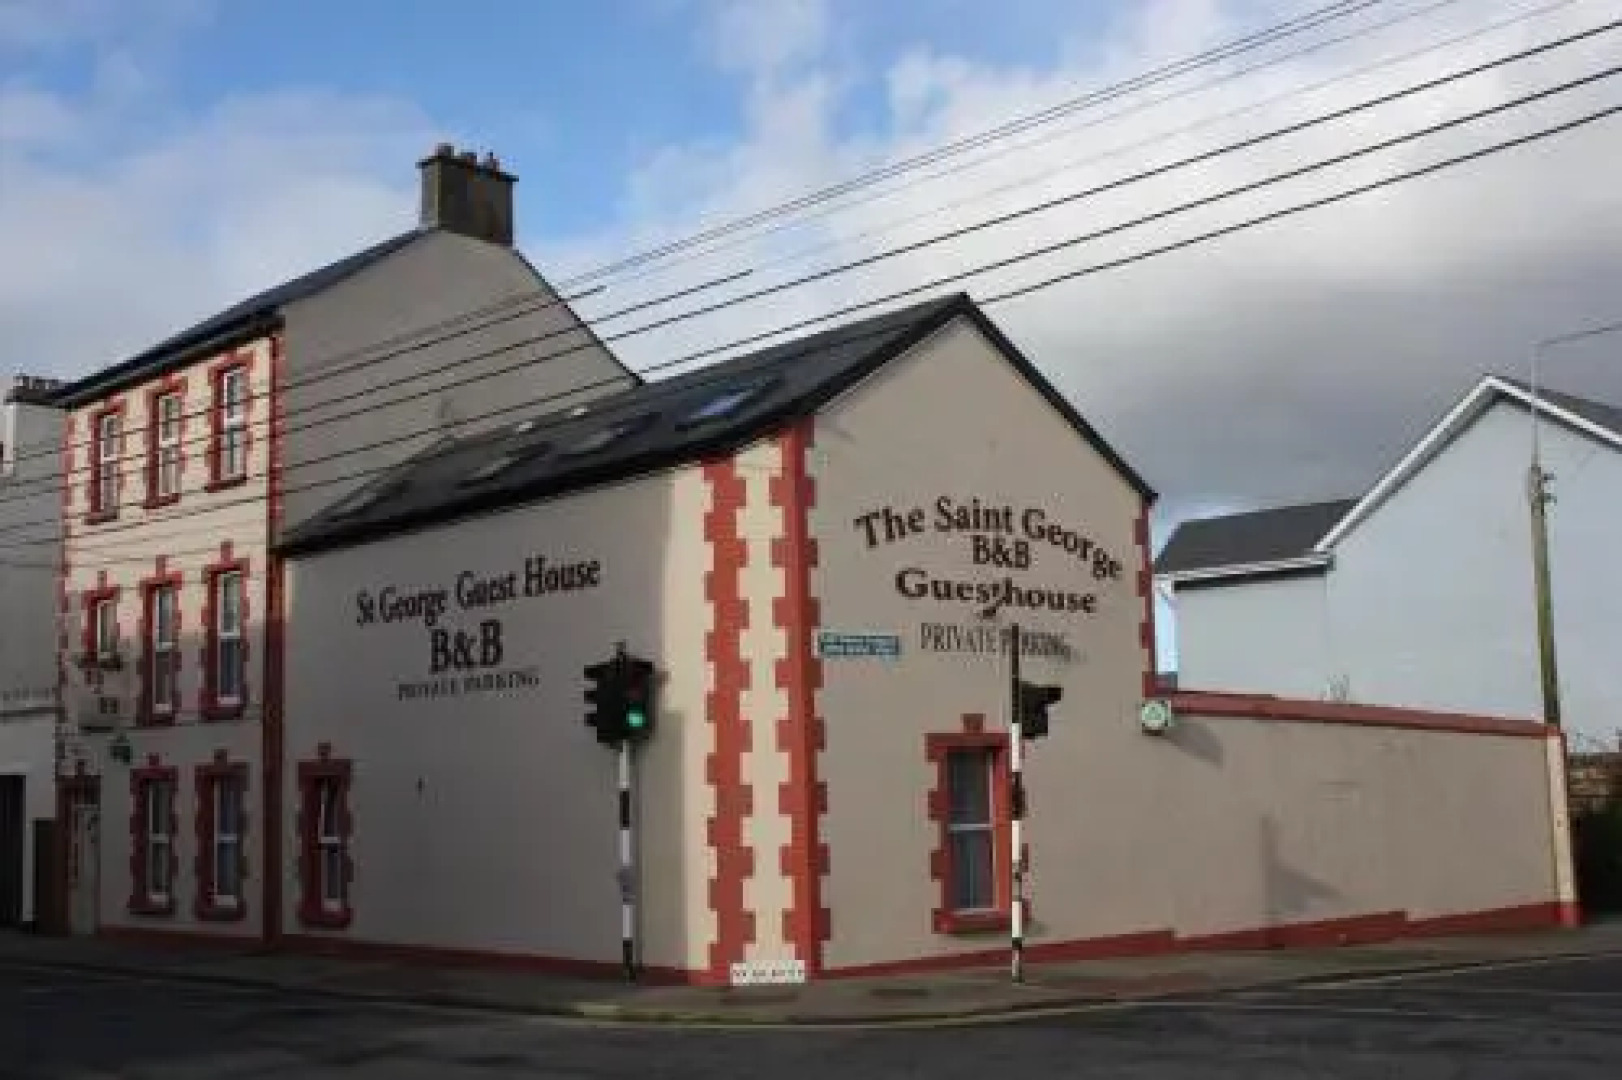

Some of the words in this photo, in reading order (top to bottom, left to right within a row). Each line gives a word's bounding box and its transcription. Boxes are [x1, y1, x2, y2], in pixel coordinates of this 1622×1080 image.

[853, 506, 925, 549] The
[934, 496, 1013, 533] Saint
[1022, 508, 1122, 578] George
[972, 534, 1029, 571] B&B
[379, 586, 448, 628] George
[456, 570, 516, 609] Guest
[524, 555, 601, 598] House
[895, 567, 1097, 613] Guesthouse
[429, 619, 503, 674] B&B
[920, 622, 997, 653] PRIVATE
